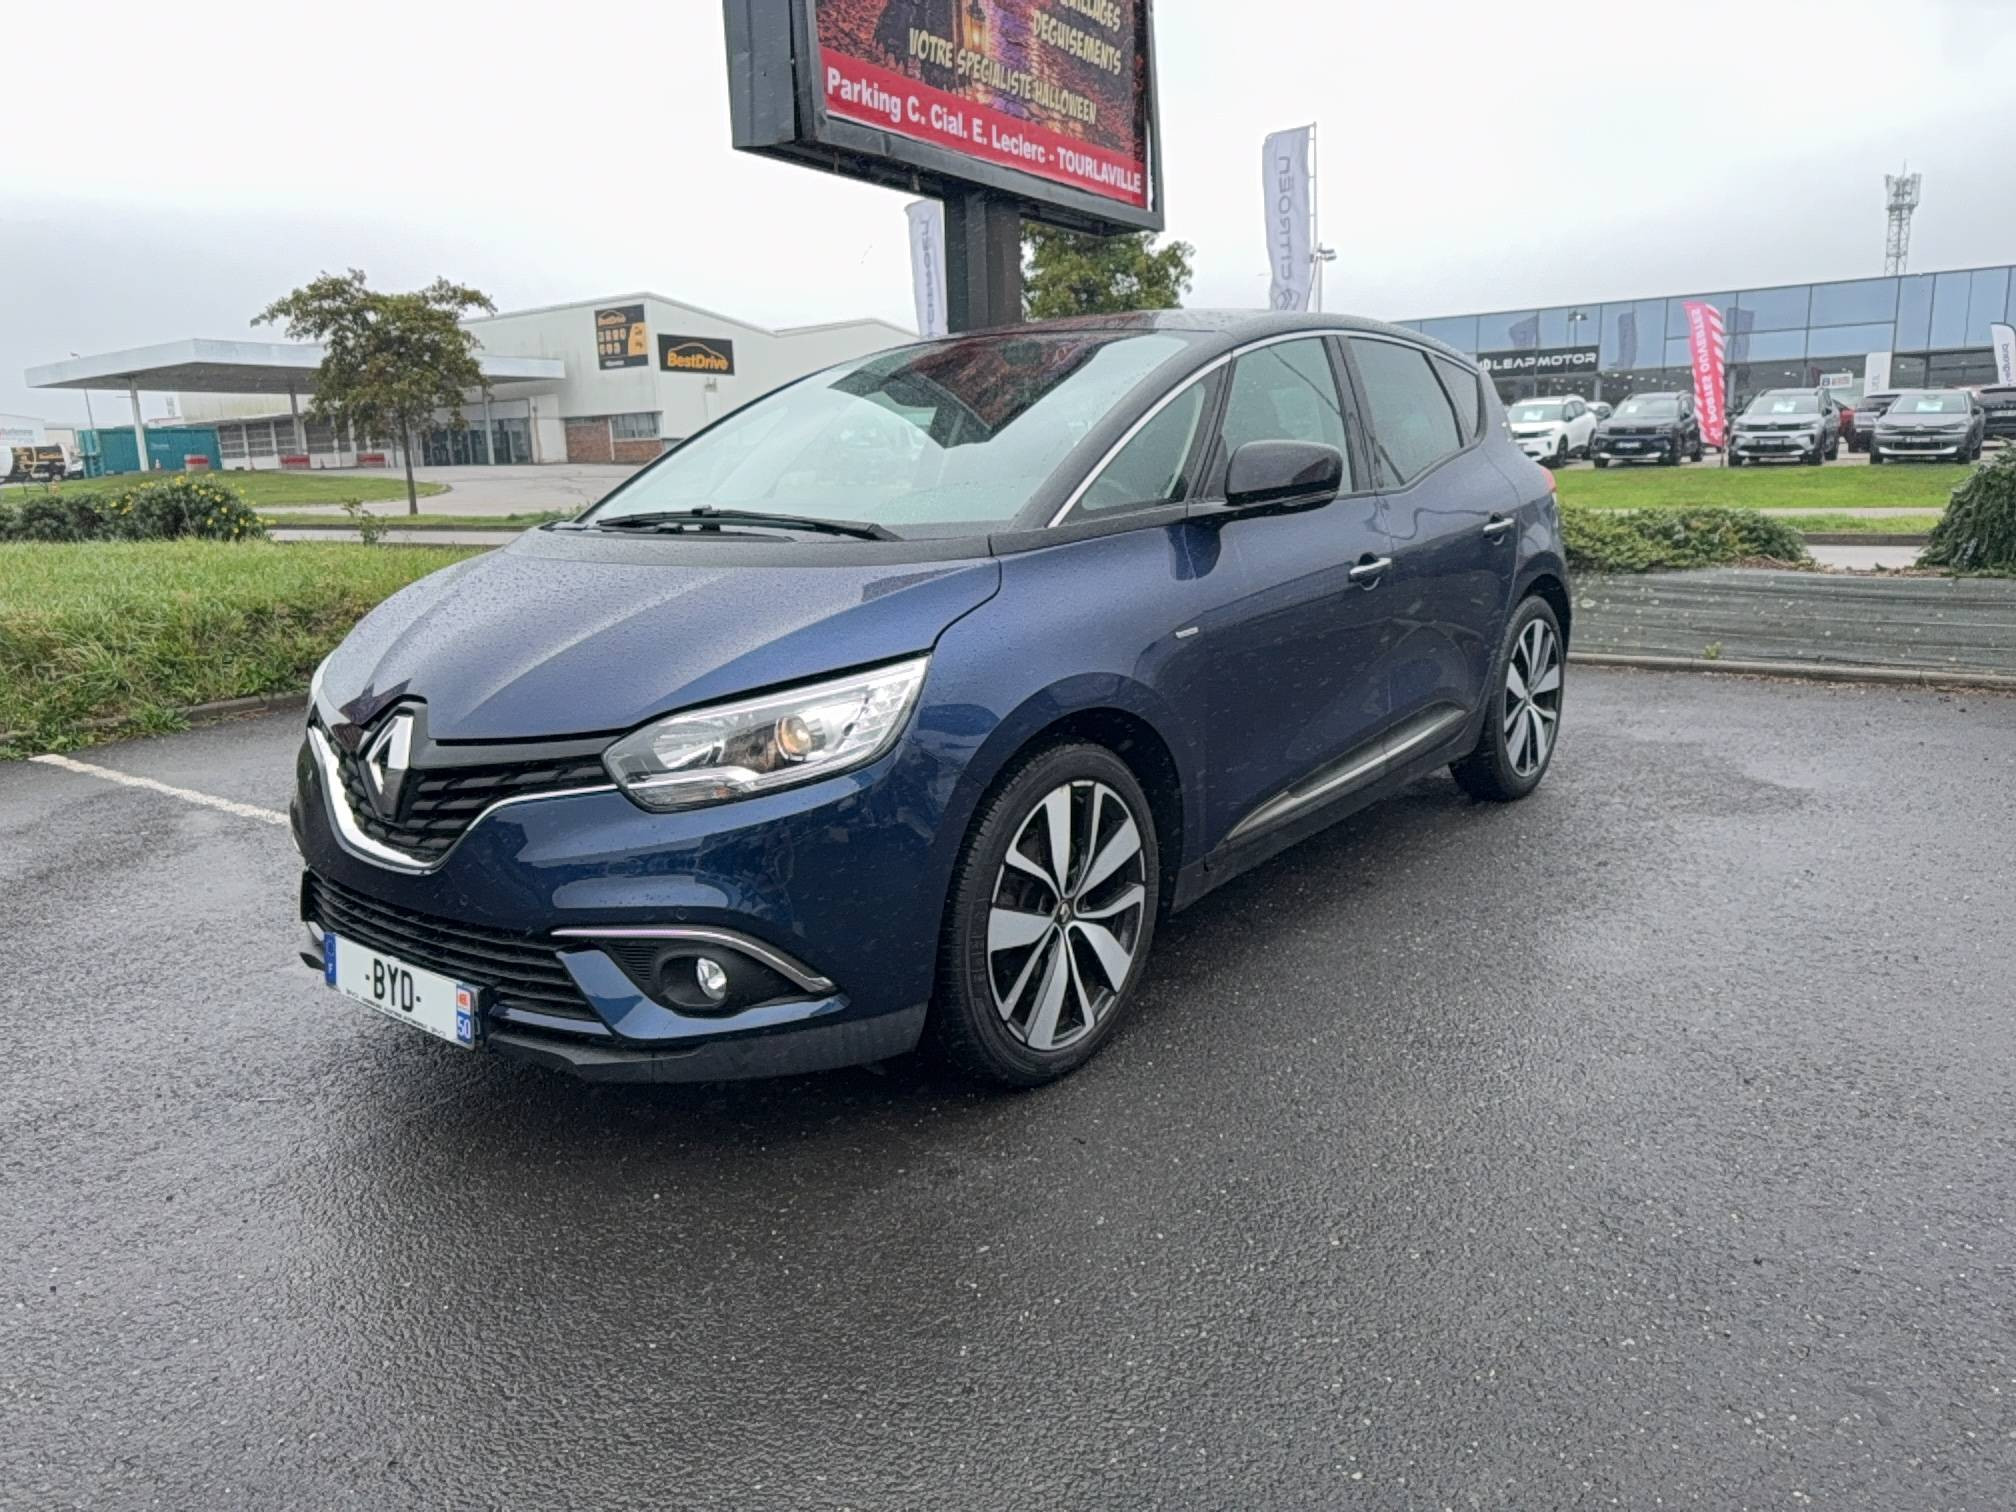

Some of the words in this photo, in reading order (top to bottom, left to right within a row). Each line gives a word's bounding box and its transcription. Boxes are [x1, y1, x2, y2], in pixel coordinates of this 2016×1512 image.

[1032, 10, 1121, 75] DEGUISEMENTS
[909, 28, 953, 68] VOTRE
[957, 48, 1032, 99] SPECIALISTE
[1034, 80, 1097, 125] HALLOWEEN
[827, 66, 901, 123] Parking
[907, 95, 925, 124] C.
[931, 104, 967, 138] Cial.
[972, 117, 987, 145] E.
[992, 124, 1045, 163] Leclerc
[1057, 147, 1141, 193] TOURLAVILLE
[667, 351, 729, 371] BestDrive
[1493, 352, 1597, 370] LEAPMOTOR
[458, 1015, 471, 1039] 50
